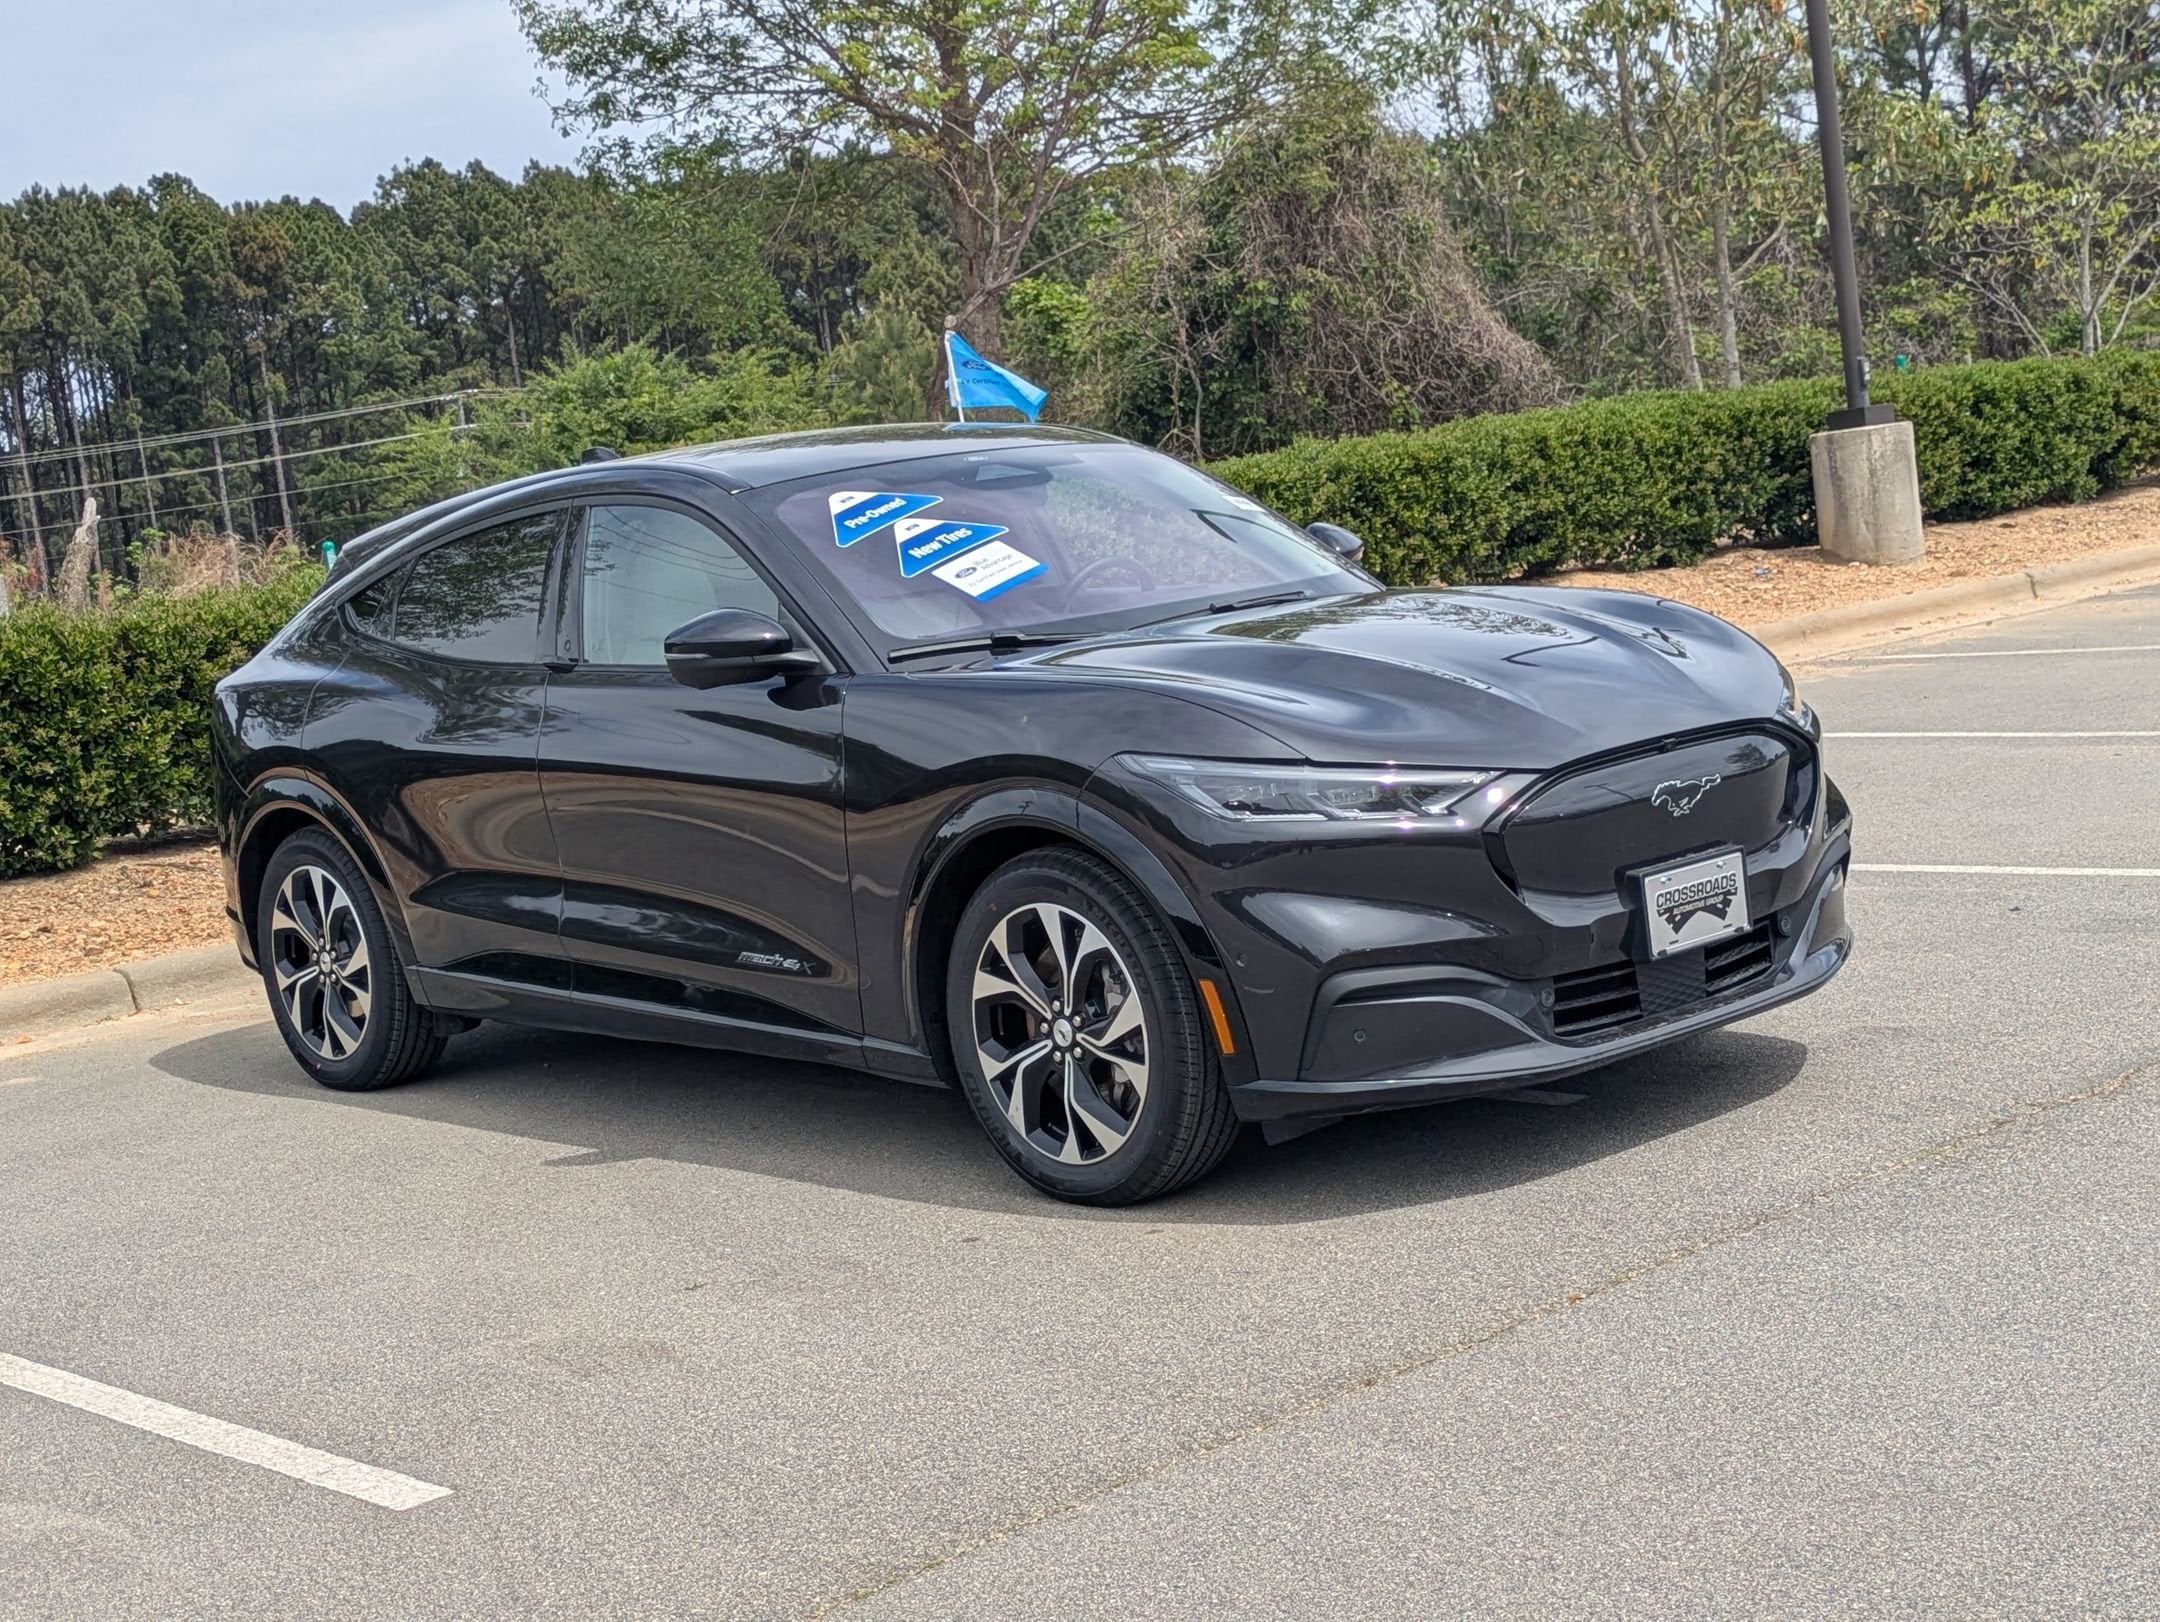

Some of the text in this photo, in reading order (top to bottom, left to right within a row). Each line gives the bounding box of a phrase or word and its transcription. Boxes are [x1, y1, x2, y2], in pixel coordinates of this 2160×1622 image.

[843, 497, 907, 528] Pre-Owned
[908, 528, 973, 559] New Tires
[1656, 873, 1737, 909] CROSSROADS
[1673, 894, 1724, 915] AUTOMOTIVE GROUP
